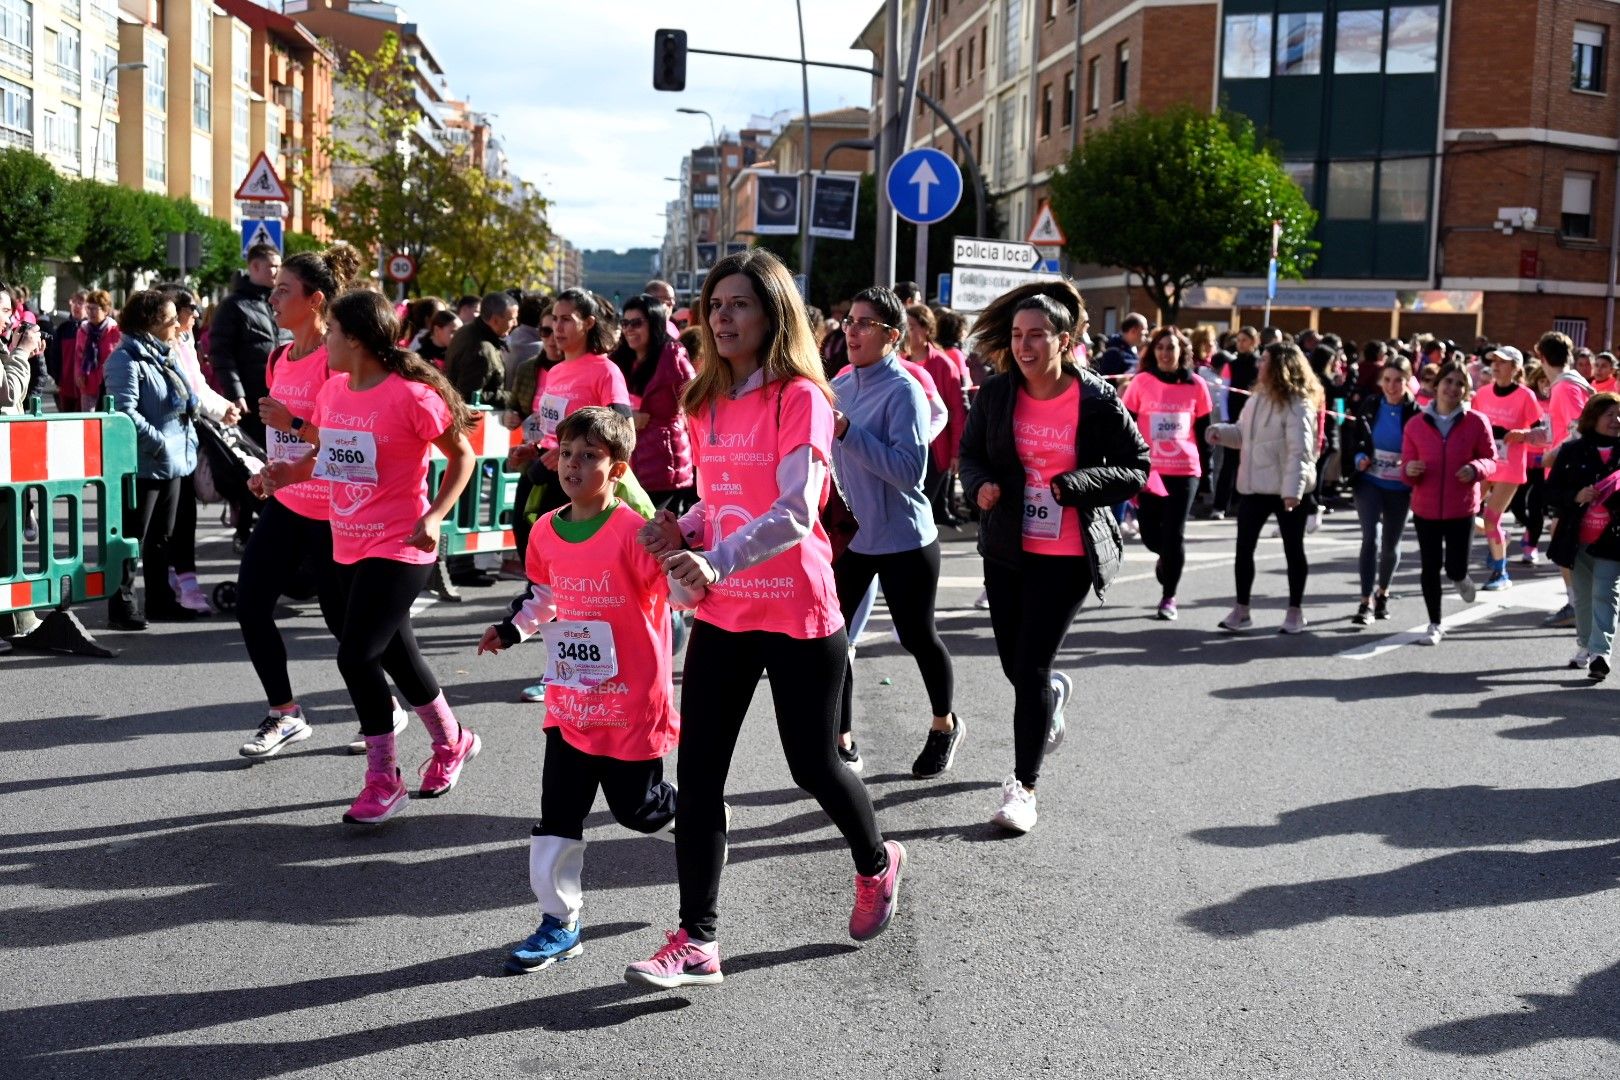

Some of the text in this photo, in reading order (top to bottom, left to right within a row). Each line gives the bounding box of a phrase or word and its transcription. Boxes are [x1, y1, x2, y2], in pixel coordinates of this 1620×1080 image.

[1003, 246, 1032, 262] local
[393, 262, 410, 273] 30
[328, 447, 365, 464] 3660
[729, 452, 774, 462] CAROBELS
[729, 577, 740, 587] DE
[741, 578, 754, 588] LA
[755, 577, 794, 589] MUJER
[581, 595, 626, 604] CAROBELS
[727, 590, 795, 599] DRASANVI
[557, 641, 601, 662] 3488
